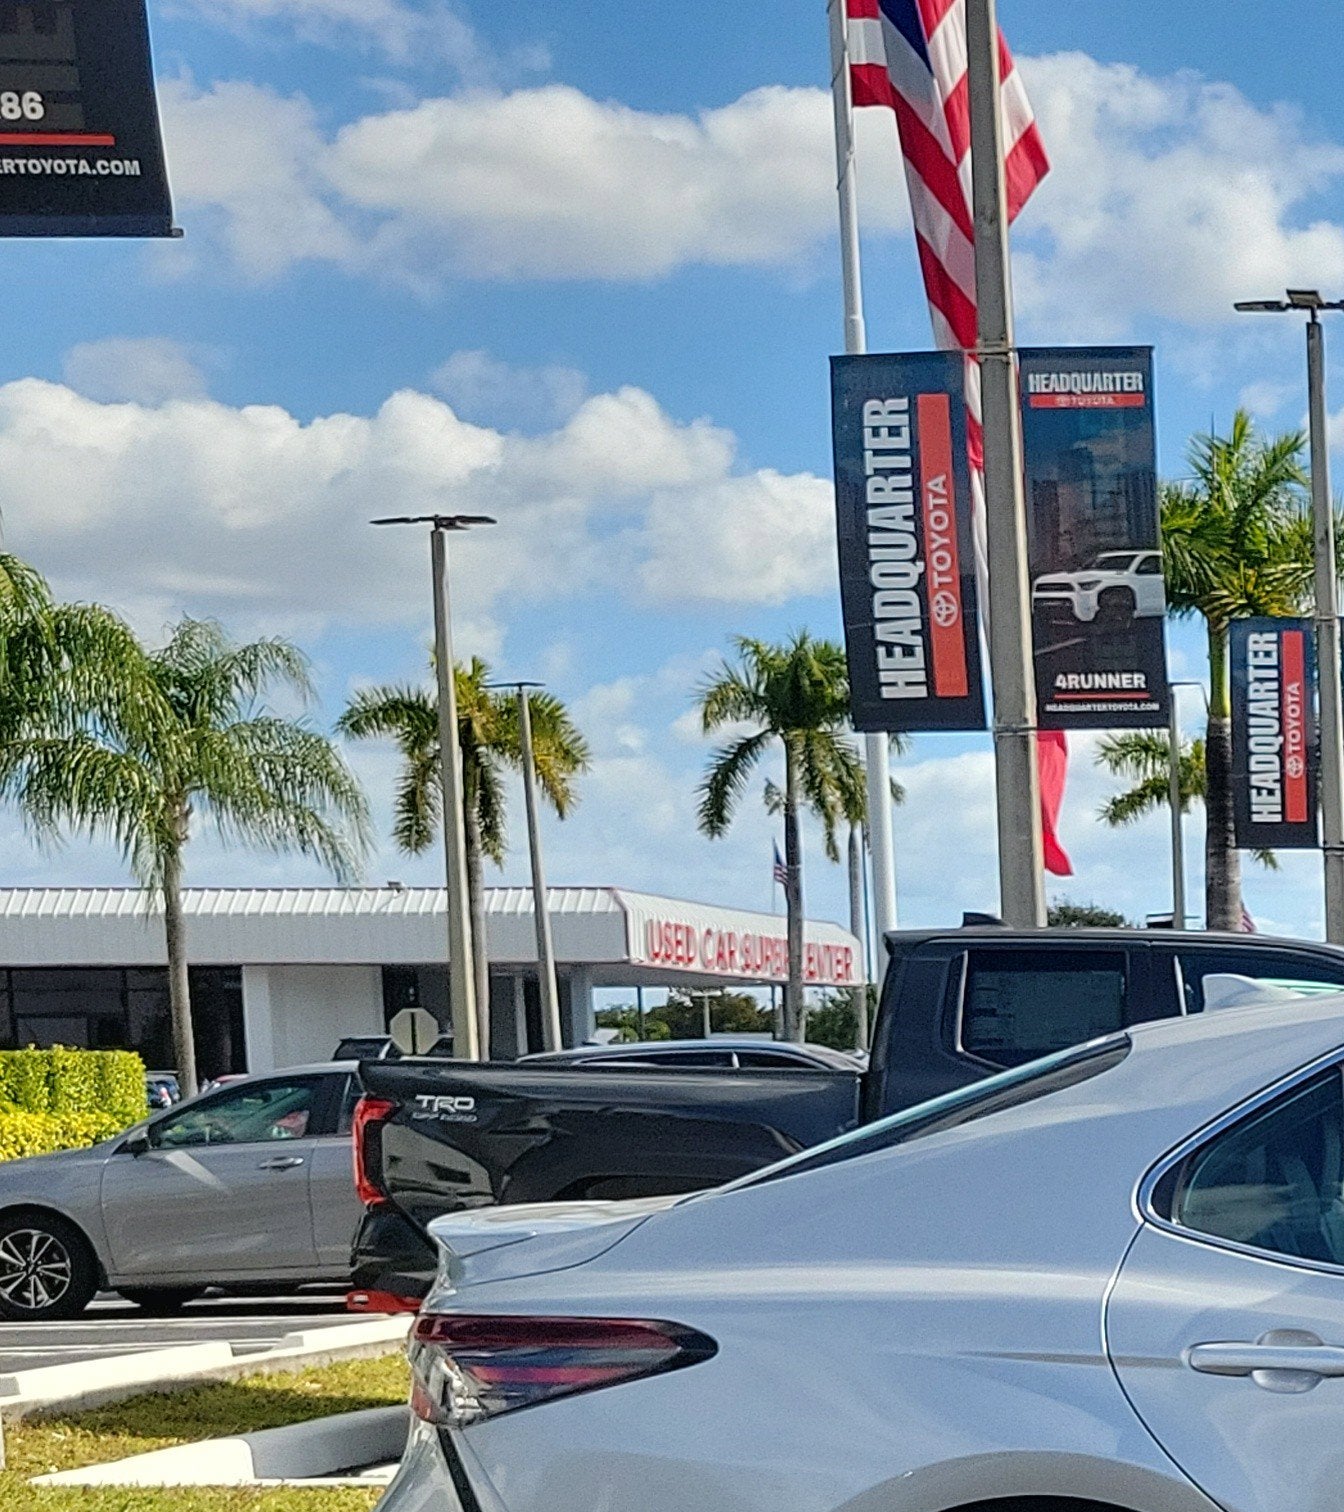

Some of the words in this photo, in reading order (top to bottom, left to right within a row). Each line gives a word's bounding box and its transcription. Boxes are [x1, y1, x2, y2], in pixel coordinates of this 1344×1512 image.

[0, 91, 45, 120] 86
[0, 159, 141, 175] RTOYOTA.COM
[1028, 372, 1143, 394] HEADQUARTER
[863, 396, 926, 699] HEADQUARTER
[926, 474, 955, 588] TOYOTA
[1055, 672, 1147, 689] 4RUNNER
[1247, 632, 1284, 822] HEADQUARTER
[1287, 682, 1302, 753] TOYOTA
[647, 919, 696, 963] USED
[702, 928, 738, 970] CAR
[415, 1094, 475, 1113] TRD
